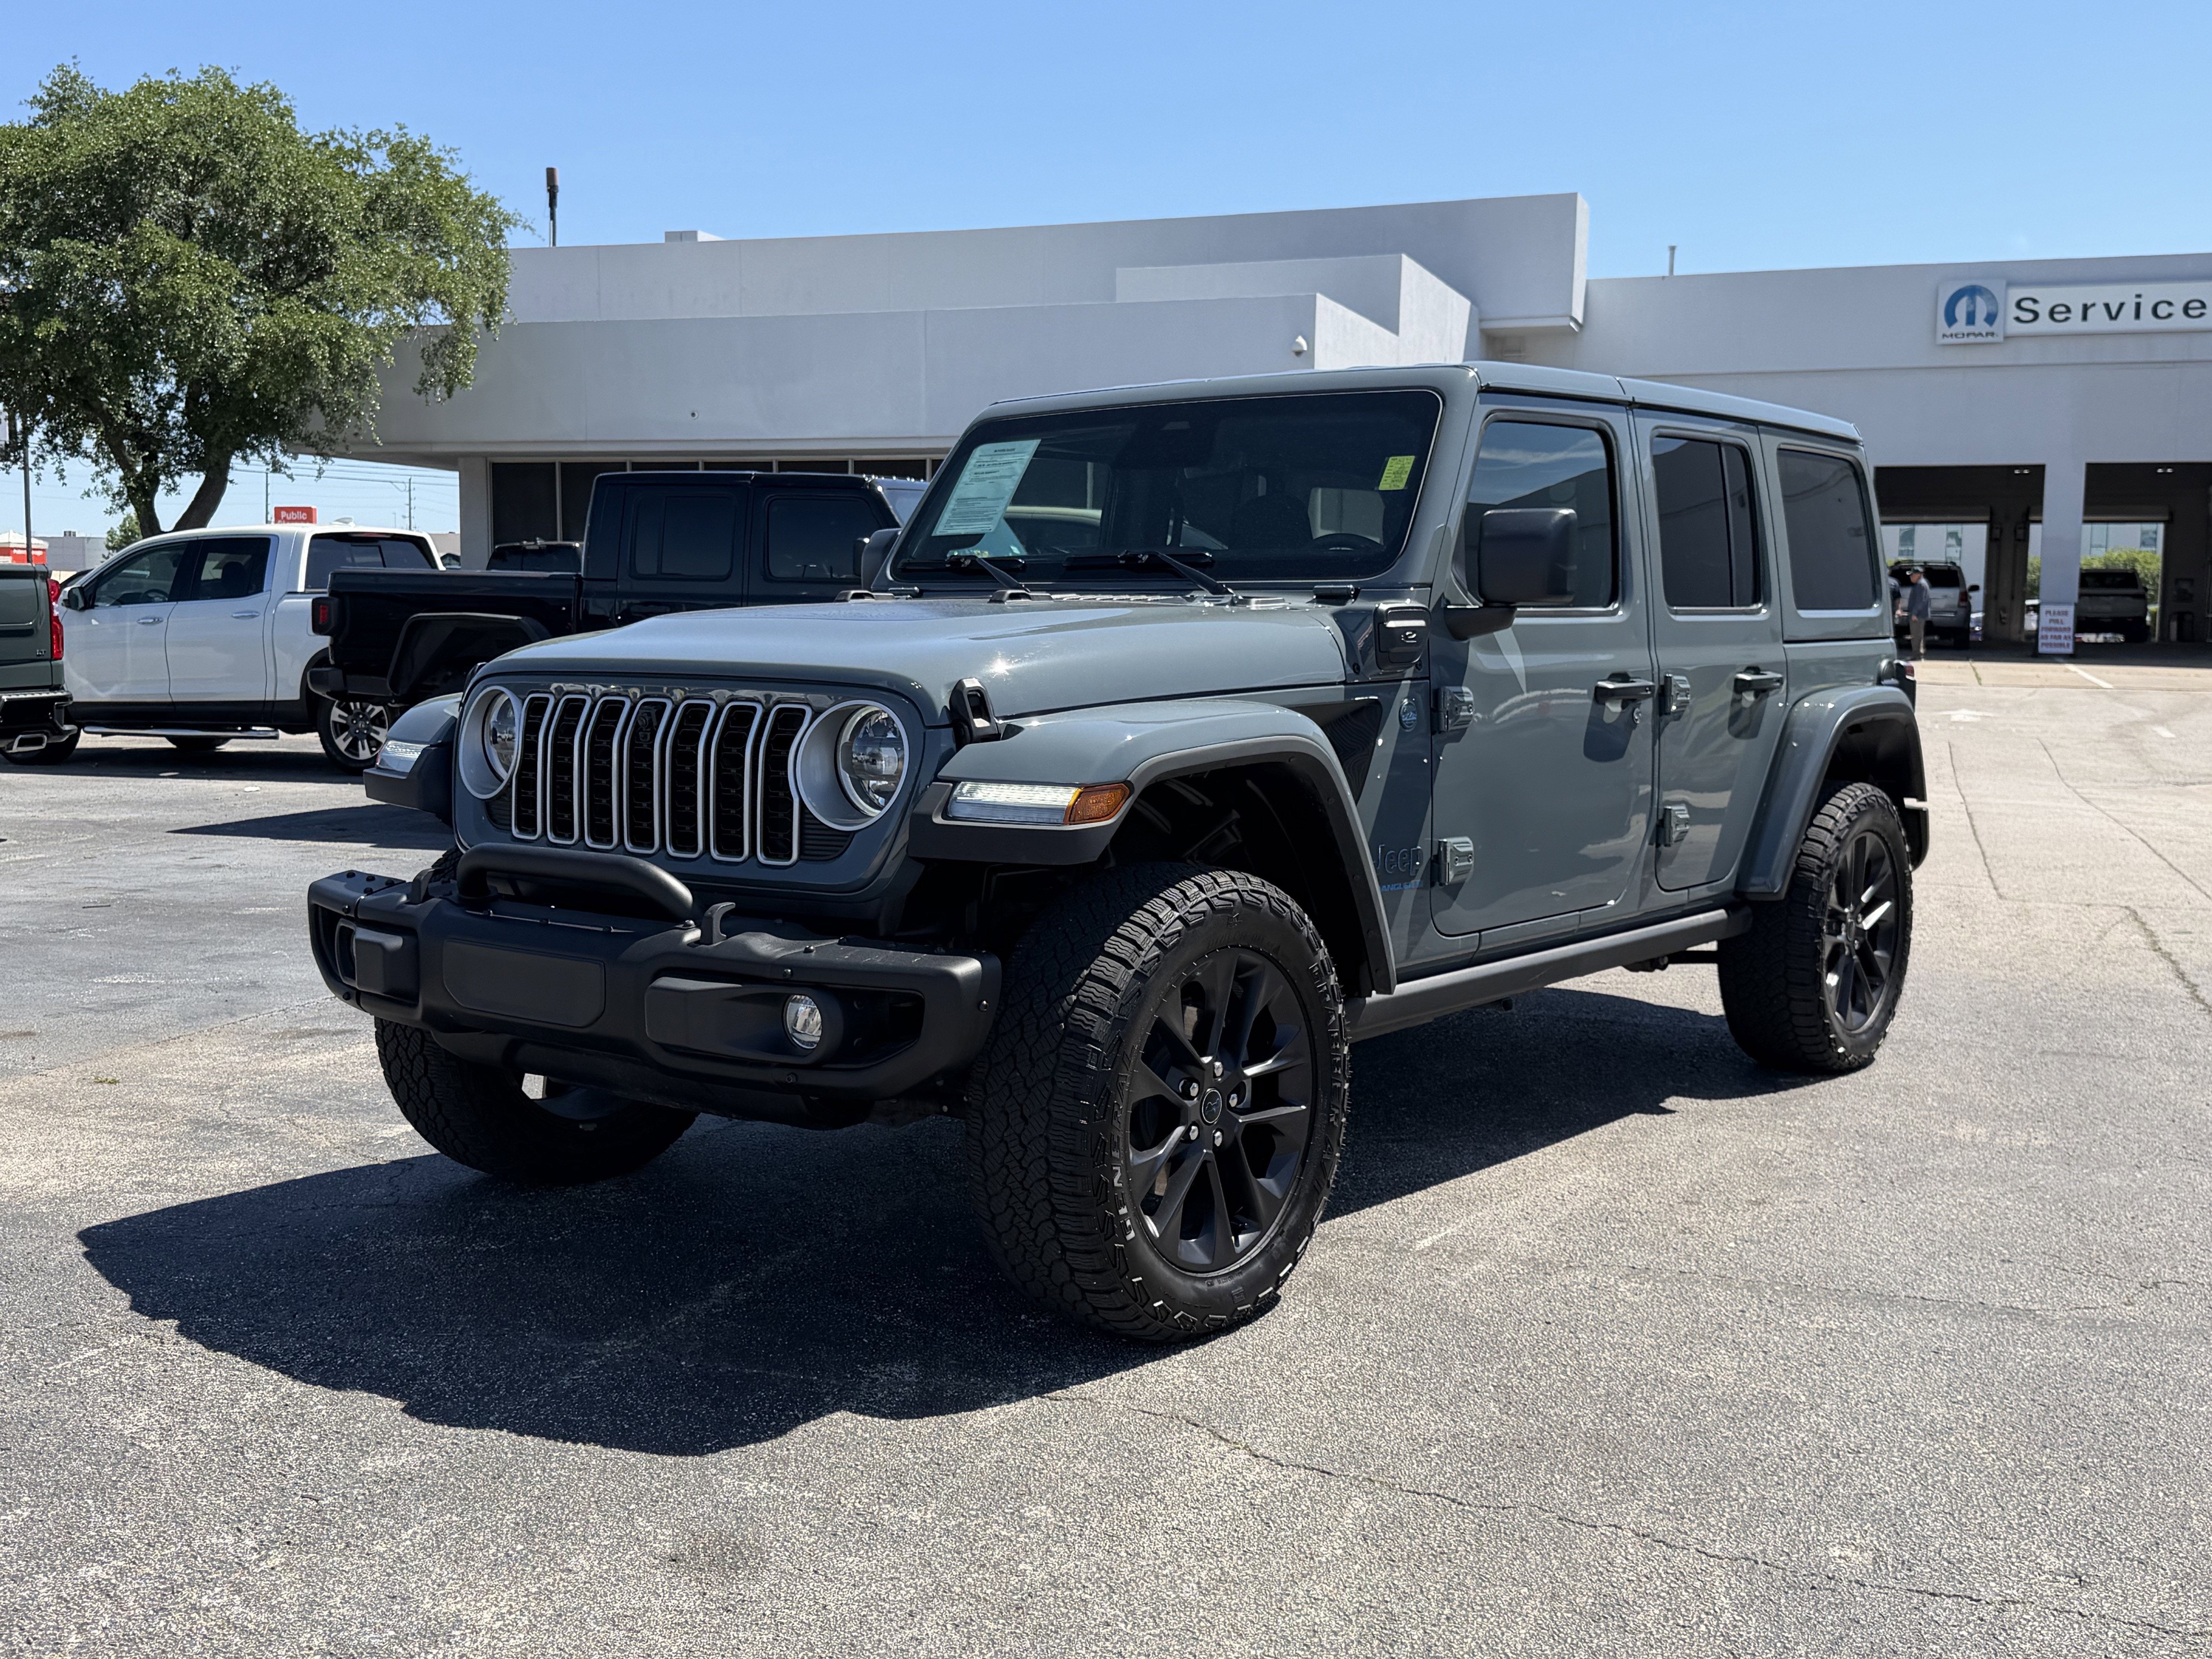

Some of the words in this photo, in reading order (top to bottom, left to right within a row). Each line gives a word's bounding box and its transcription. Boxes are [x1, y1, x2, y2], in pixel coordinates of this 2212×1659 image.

[2013, 293, 2207, 324] Service
[281, 510, 307, 519] Public
[1377, 844, 1424, 876] Jeep
[1110, 1044, 1138, 1242] GENERAL
